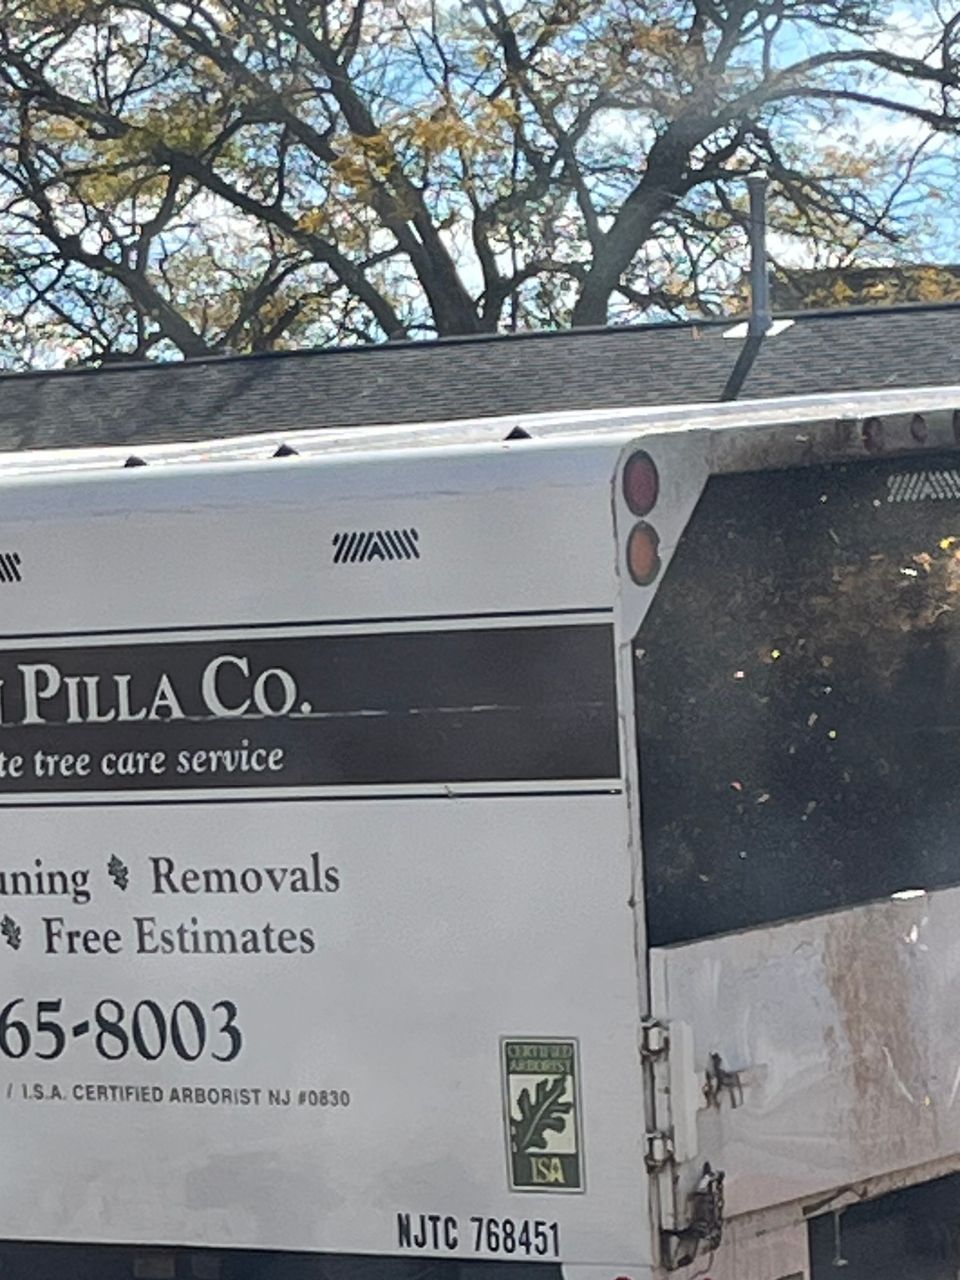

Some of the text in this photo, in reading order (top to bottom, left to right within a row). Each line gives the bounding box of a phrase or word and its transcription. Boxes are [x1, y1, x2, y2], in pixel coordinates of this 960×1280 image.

[18, 664, 178, 724] PILLA
[35, 751, 90, 776] tree
[102, 753, 165, 774] care
[177, 740, 282, 772] service
[149, 852, 339, 893] Removals
[42, 918, 121, 953] Free
[133, 917, 314, 953] Estimates
[72, 1084, 164, 1103] CERTIFIED
[169, 1086, 262, 1106] ARBORIST
[268, 1089, 291, 1106] NJ
[298, 1089, 351, 1107] #0830
[531, 1158, 564, 1183] ISA
[398, 1213, 559, 1257] NJTC 768451
